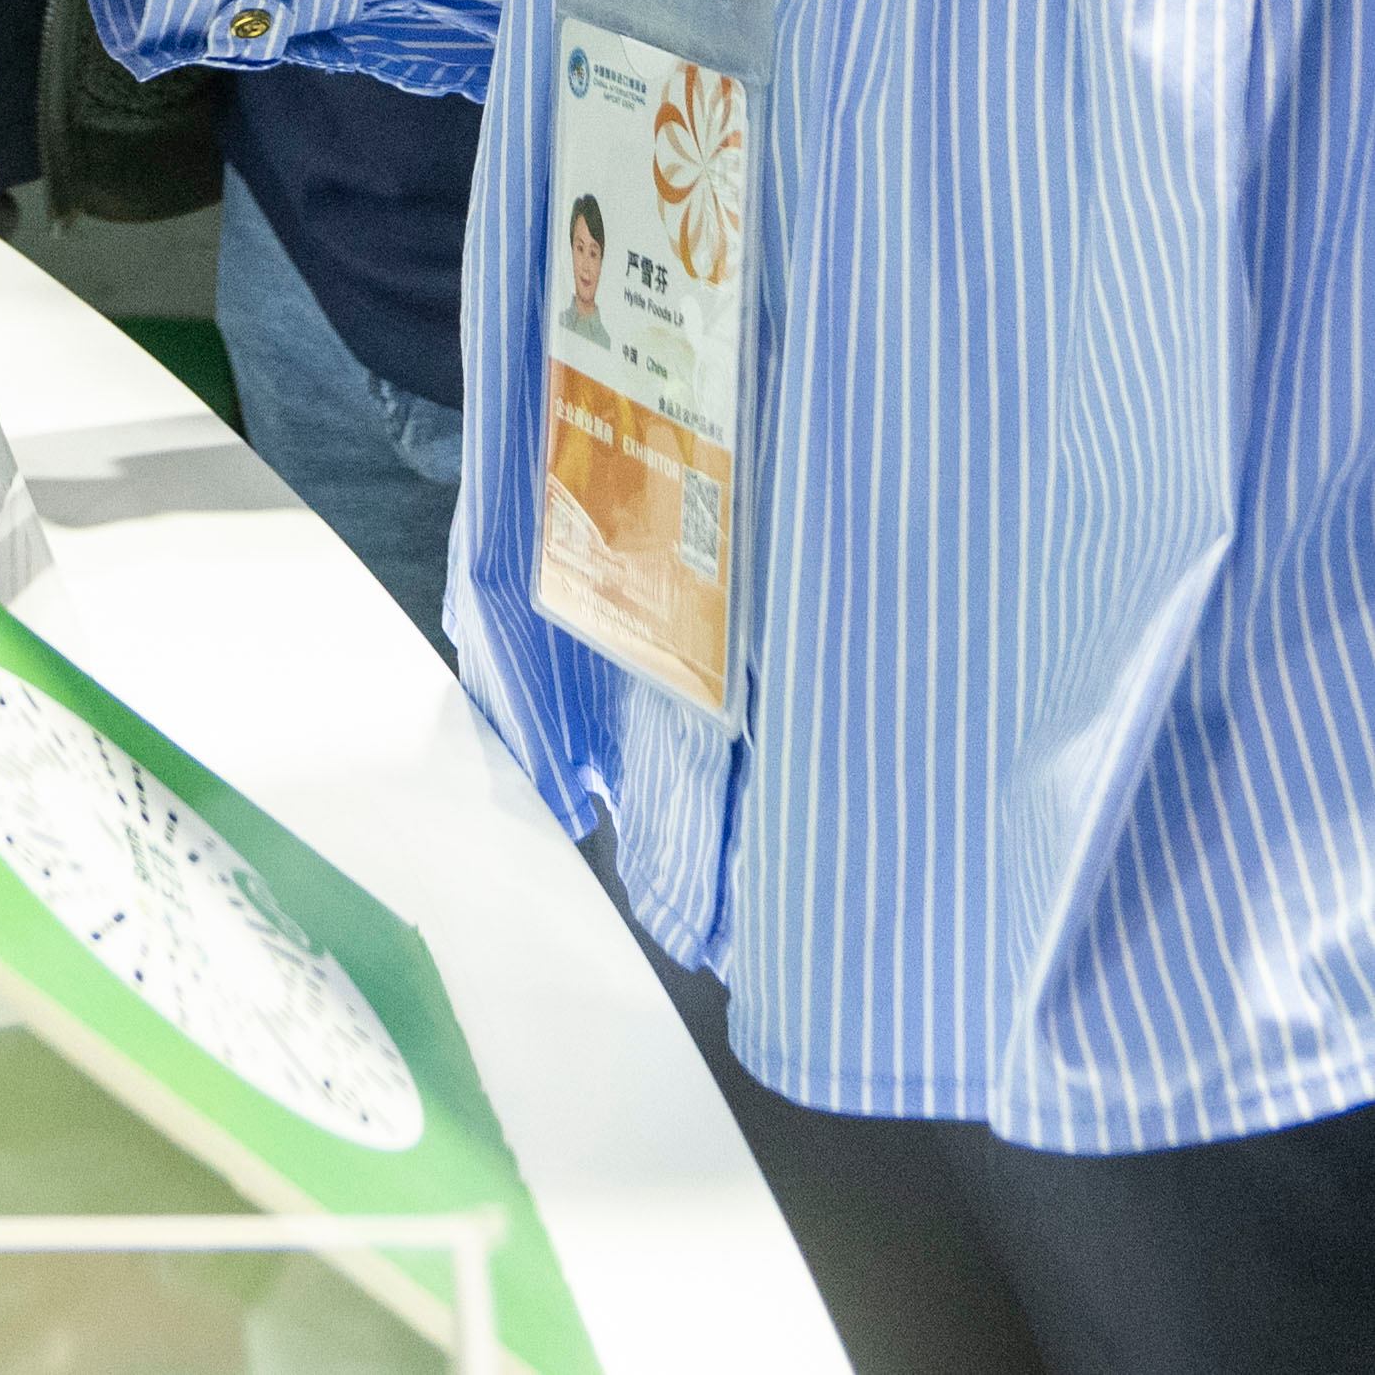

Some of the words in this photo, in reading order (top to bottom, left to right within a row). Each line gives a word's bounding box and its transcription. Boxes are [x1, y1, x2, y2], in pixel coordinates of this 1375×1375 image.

[626, 250, 668, 295] 严雪芬
[647, 297, 673, 324] Foods
[622, 343, 638, 366] 中国
[646, 355, 668, 380] China
[622, 433, 681, 482] EXHIBITOR
